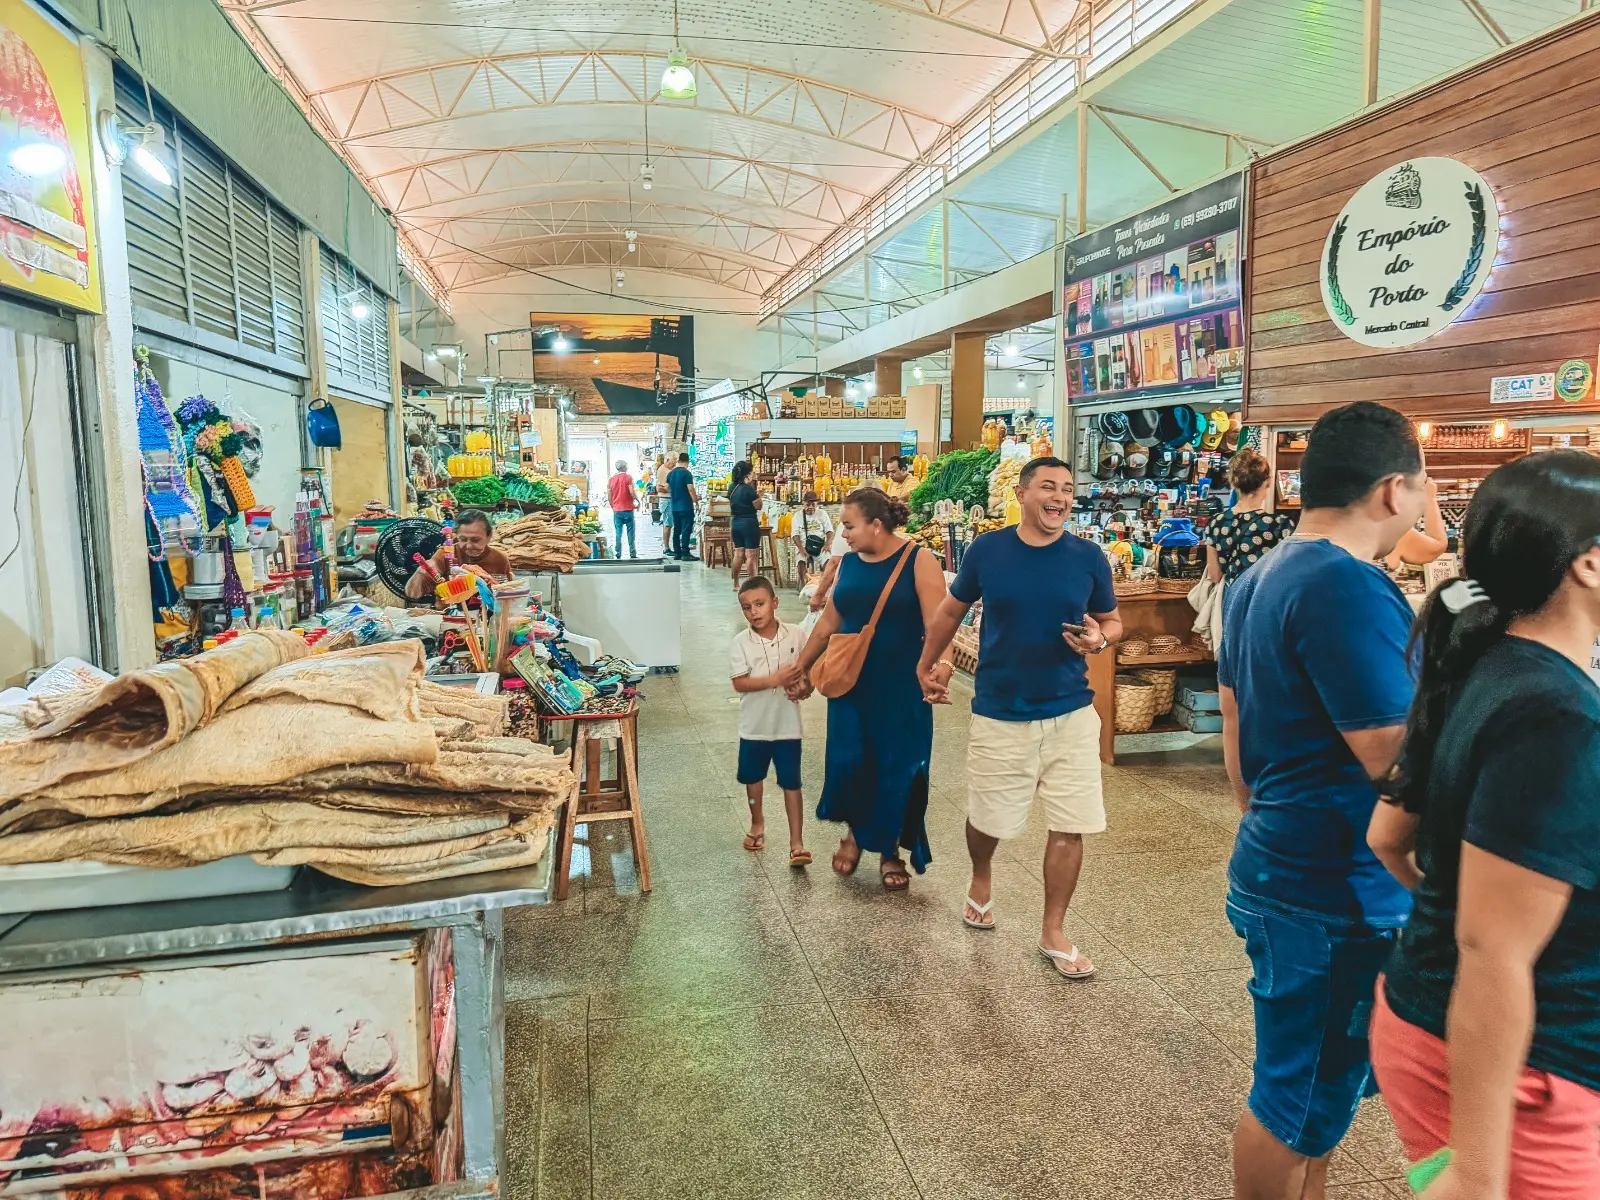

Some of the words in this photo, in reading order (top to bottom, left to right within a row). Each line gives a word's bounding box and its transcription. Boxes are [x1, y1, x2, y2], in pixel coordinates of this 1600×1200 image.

[1357, 216, 1450, 252] Empório
[1384, 254, 1414, 276] do
[1368, 284, 1429, 308] Porto
[1365, 322, 1398, 335] Mercado
[1399, 317, 1430, 331] Central
[1510, 379, 1534, 391] CAT
